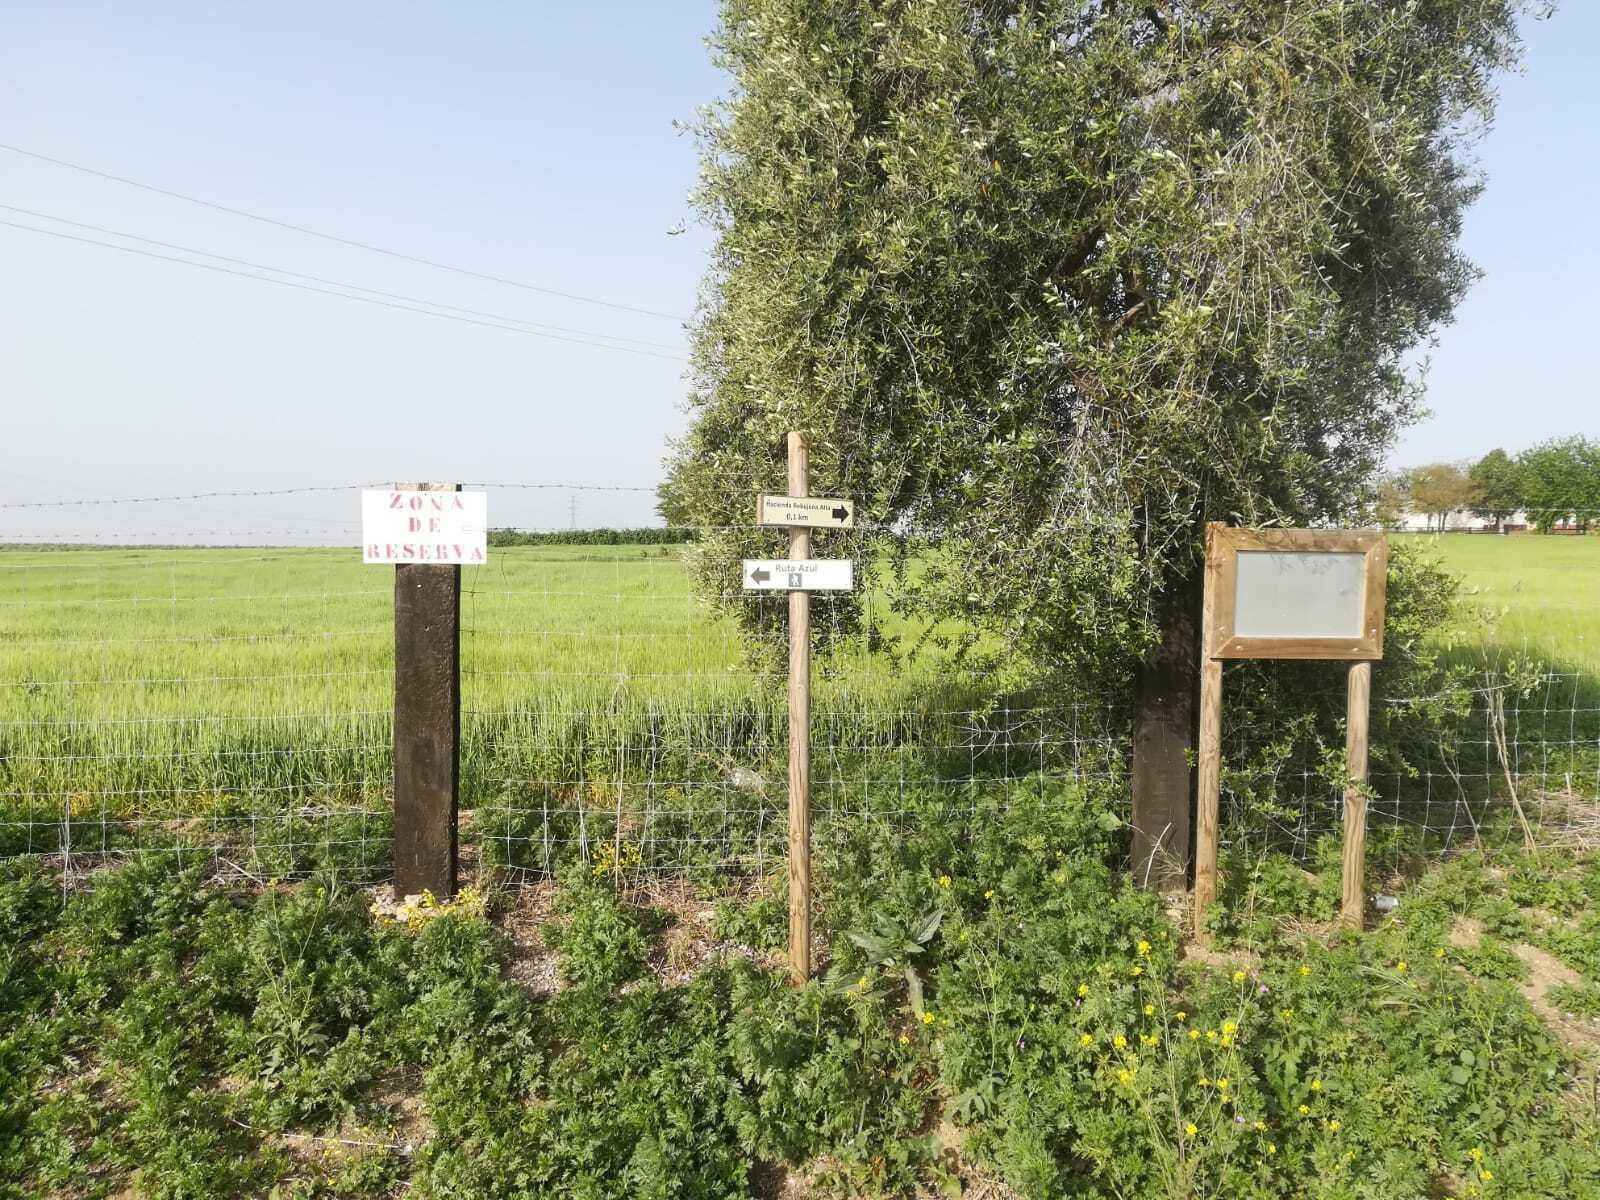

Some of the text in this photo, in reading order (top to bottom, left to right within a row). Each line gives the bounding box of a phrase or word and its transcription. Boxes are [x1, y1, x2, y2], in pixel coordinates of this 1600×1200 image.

[390, 493, 464, 511] ZONA
[408, 517, 441, 533] DE
[786, 513, 809, 521] 0,1 km
[367, 544, 484, 560] RESERVA
[775, 563, 818, 573] Ruta Azul
